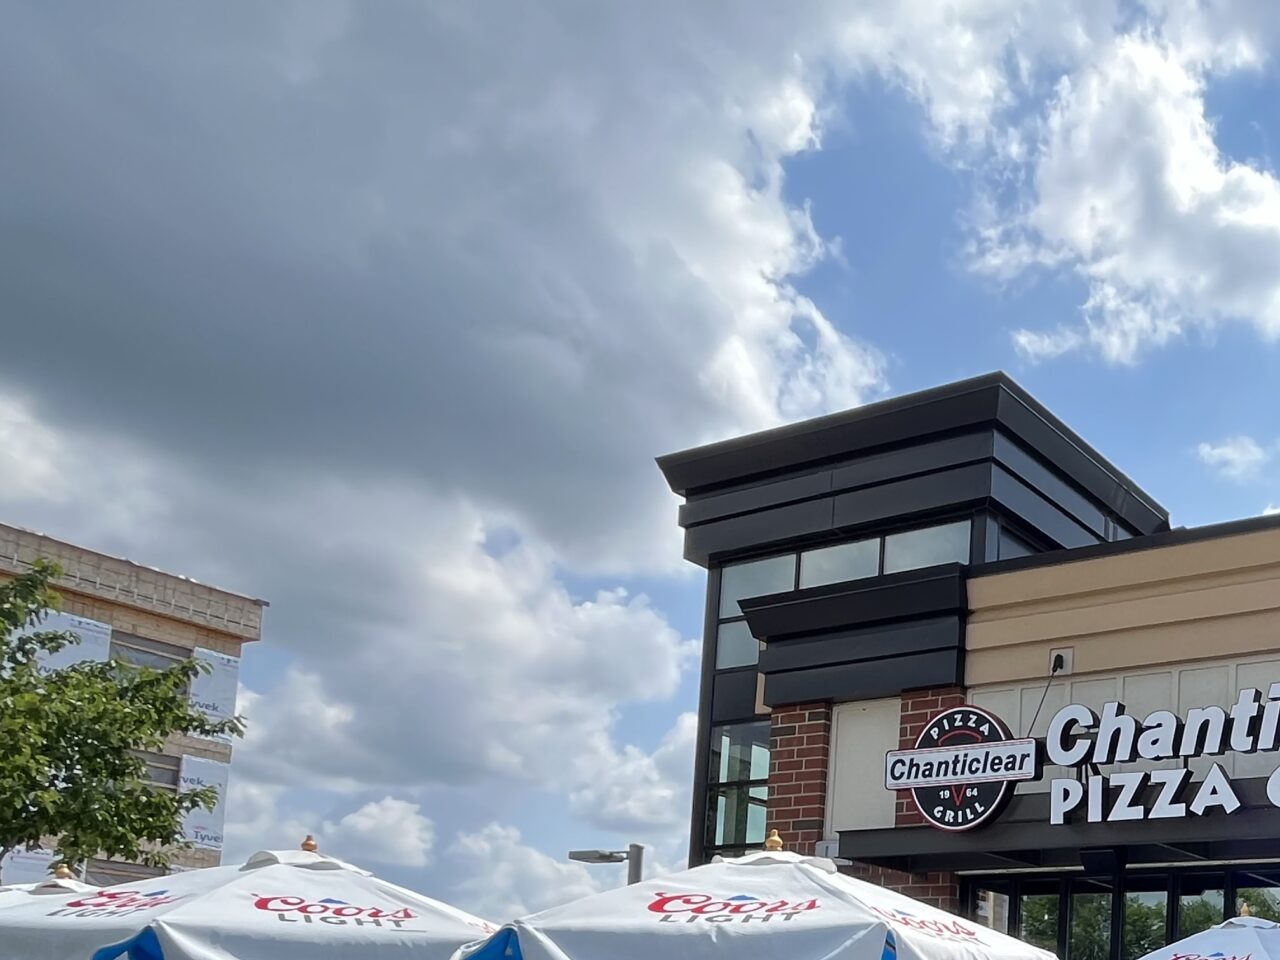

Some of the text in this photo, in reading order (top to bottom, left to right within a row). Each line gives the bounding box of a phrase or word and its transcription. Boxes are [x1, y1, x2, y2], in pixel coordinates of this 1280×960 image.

[929, 713, 990, 740] PIZZA
[889, 750, 1031, 781] Chanticlear
[938, 787, 979, 799] 19 64
[1049, 762, 1241, 825] PIZZA
[932, 801, 986, 823] GRILL
[46, 908, 147, 918] LIGHT
[249, 892, 419, 919] Coors
[647, 892, 822, 915] Coors
[277, 913, 406, 928] LIGHT
[659, 911, 804, 924] LIGHT
[870, 906, 977, 937] Coors
